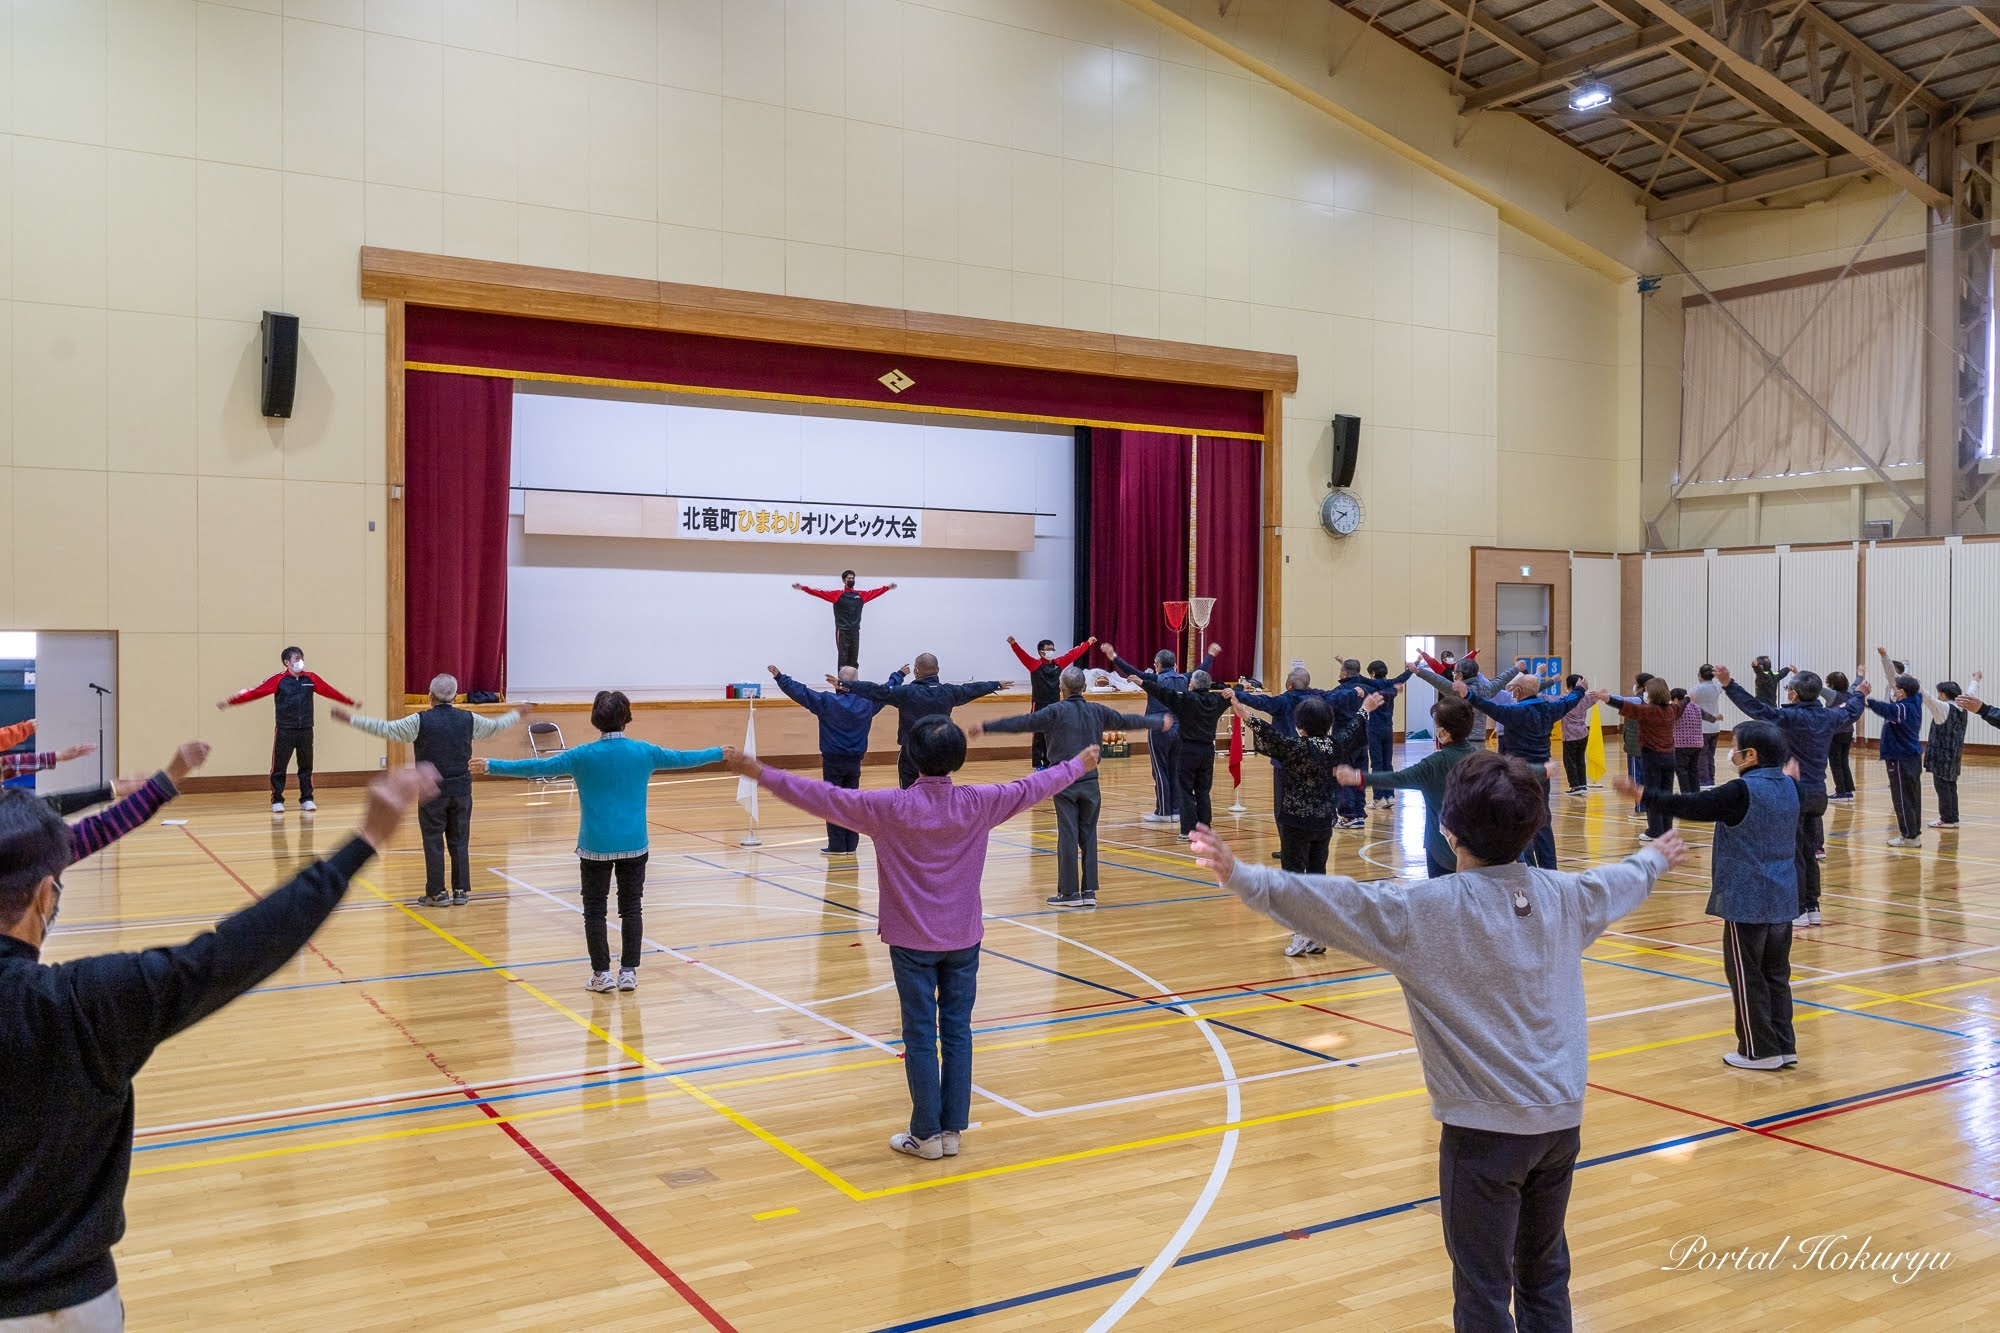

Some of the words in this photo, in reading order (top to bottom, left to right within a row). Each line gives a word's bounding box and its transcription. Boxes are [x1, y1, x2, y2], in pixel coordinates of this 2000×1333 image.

[682, 506, 918, 539] 北竜町ひまわりオリンピック大会
[1552, 662, 1558, 673] 3
